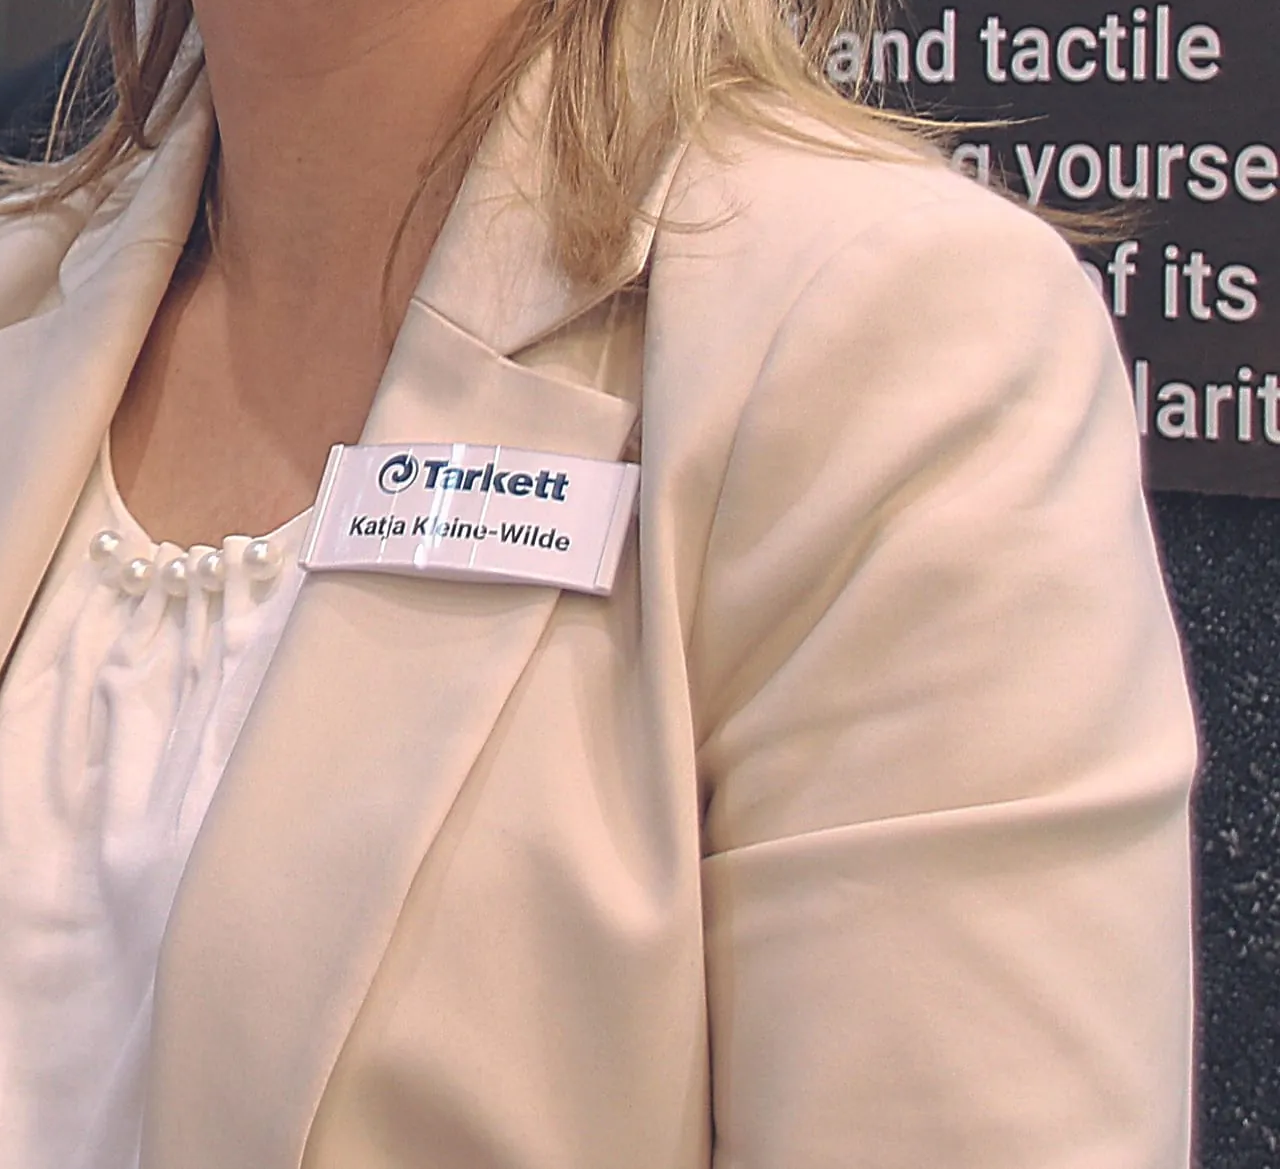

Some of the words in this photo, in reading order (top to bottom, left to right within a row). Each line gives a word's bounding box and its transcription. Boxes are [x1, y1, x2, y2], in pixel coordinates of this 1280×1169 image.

[827, 9, 956, 82] and
[979, 5, 1221, 82] tactile
[1015, 144, 1279, 205] yourse
[1164, 245, 1258, 321] its
[424, 460, 569, 501] Tarkett
[348, 516, 406, 540] Katja
[411, 515, 571, 552] Kleine-Wilde
